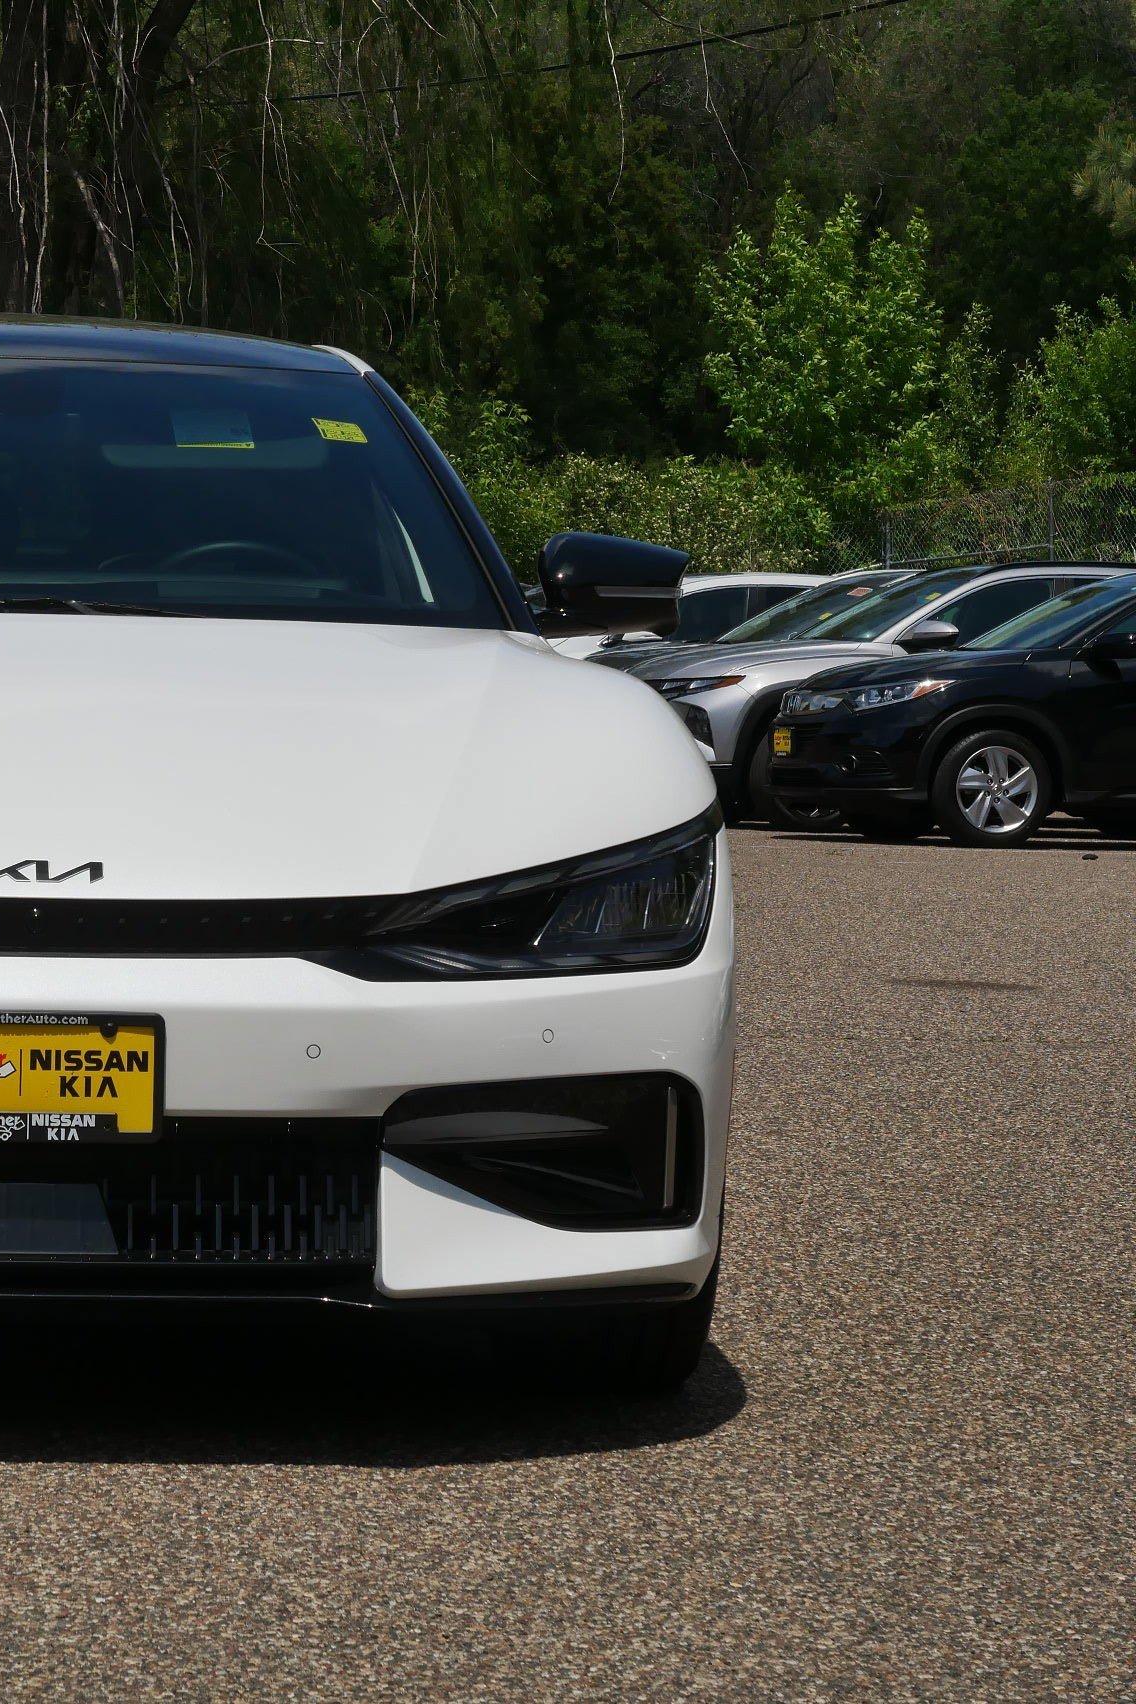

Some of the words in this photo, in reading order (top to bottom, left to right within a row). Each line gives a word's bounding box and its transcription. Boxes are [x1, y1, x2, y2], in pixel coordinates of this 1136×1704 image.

[29, 1048, 149, 1072] NISSAN
[59, 1075, 119, 1098] KIA
[31, 1113, 96, 1128] NISSAN
[47, 1127, 80, 1141] KIA
